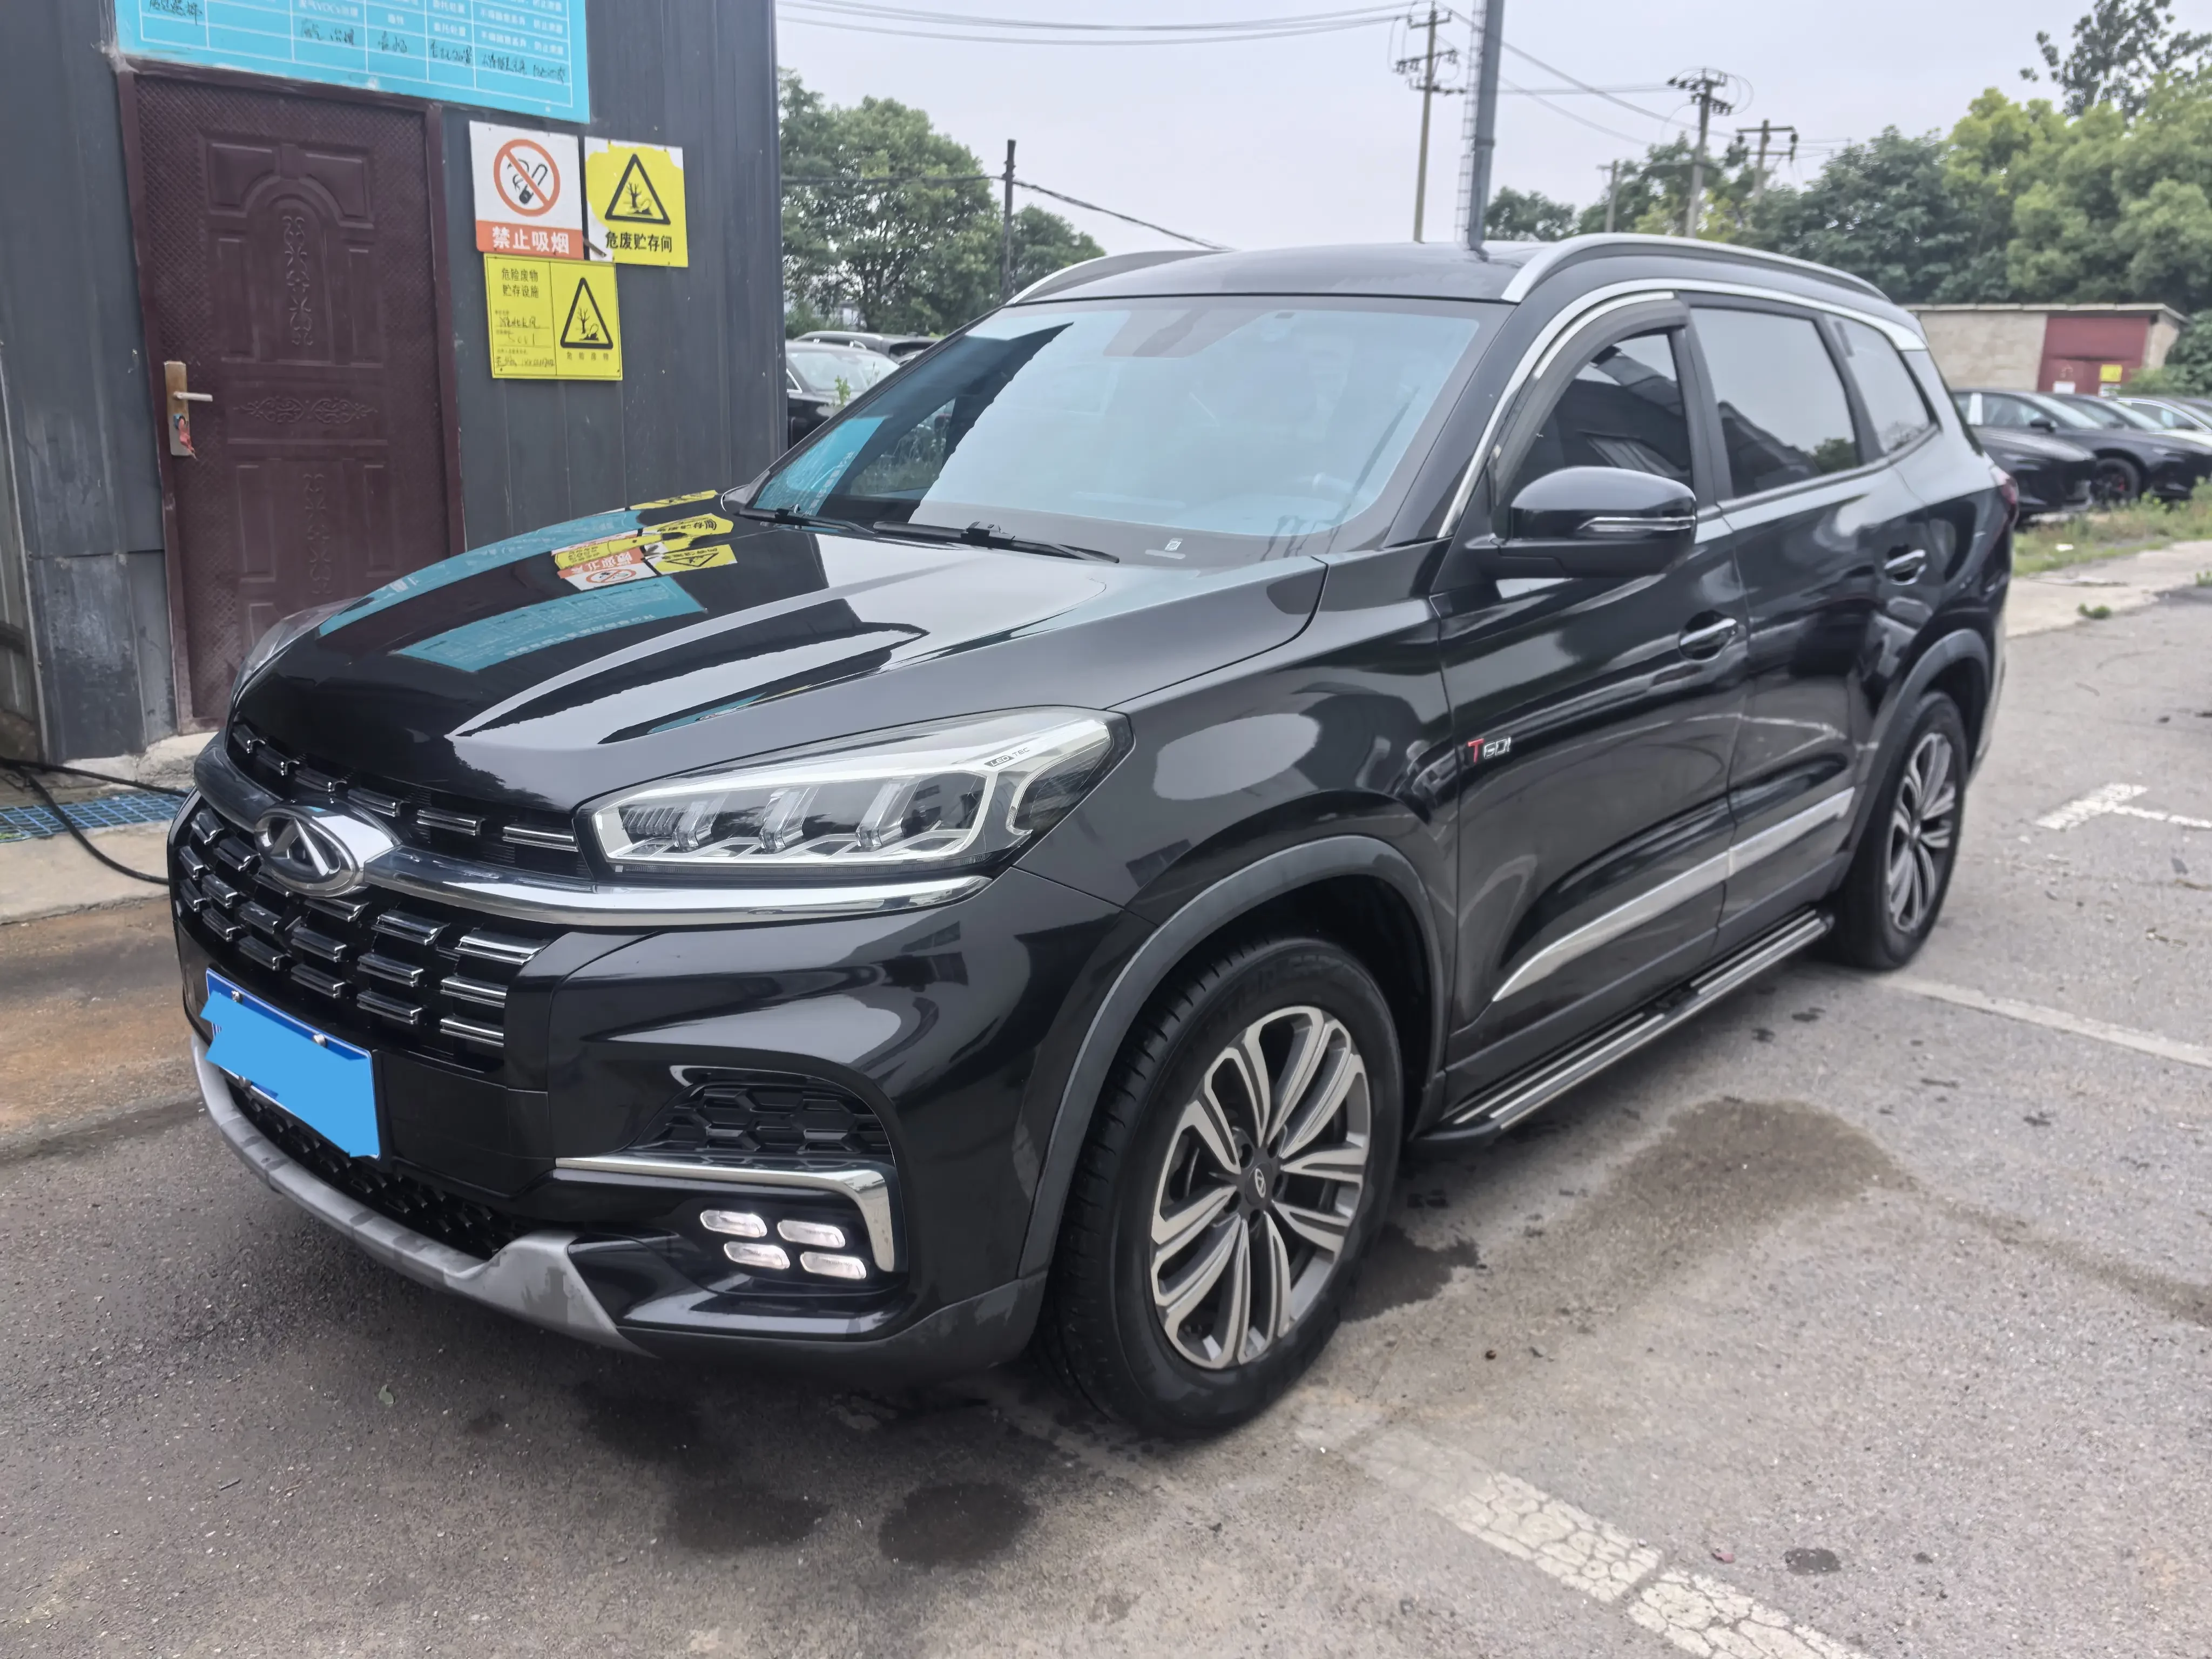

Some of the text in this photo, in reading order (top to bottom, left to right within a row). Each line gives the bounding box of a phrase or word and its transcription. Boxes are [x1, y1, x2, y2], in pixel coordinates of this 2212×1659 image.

[493, 226, 569, 254] 禁止吸烟
[605, 231, 672, 252] 危废贮存间
[502, 268, 538, 282] 危险废物
[503, 284, 539, 298] 贮存设施
[990, 747, 1030, 766] LED TEC
